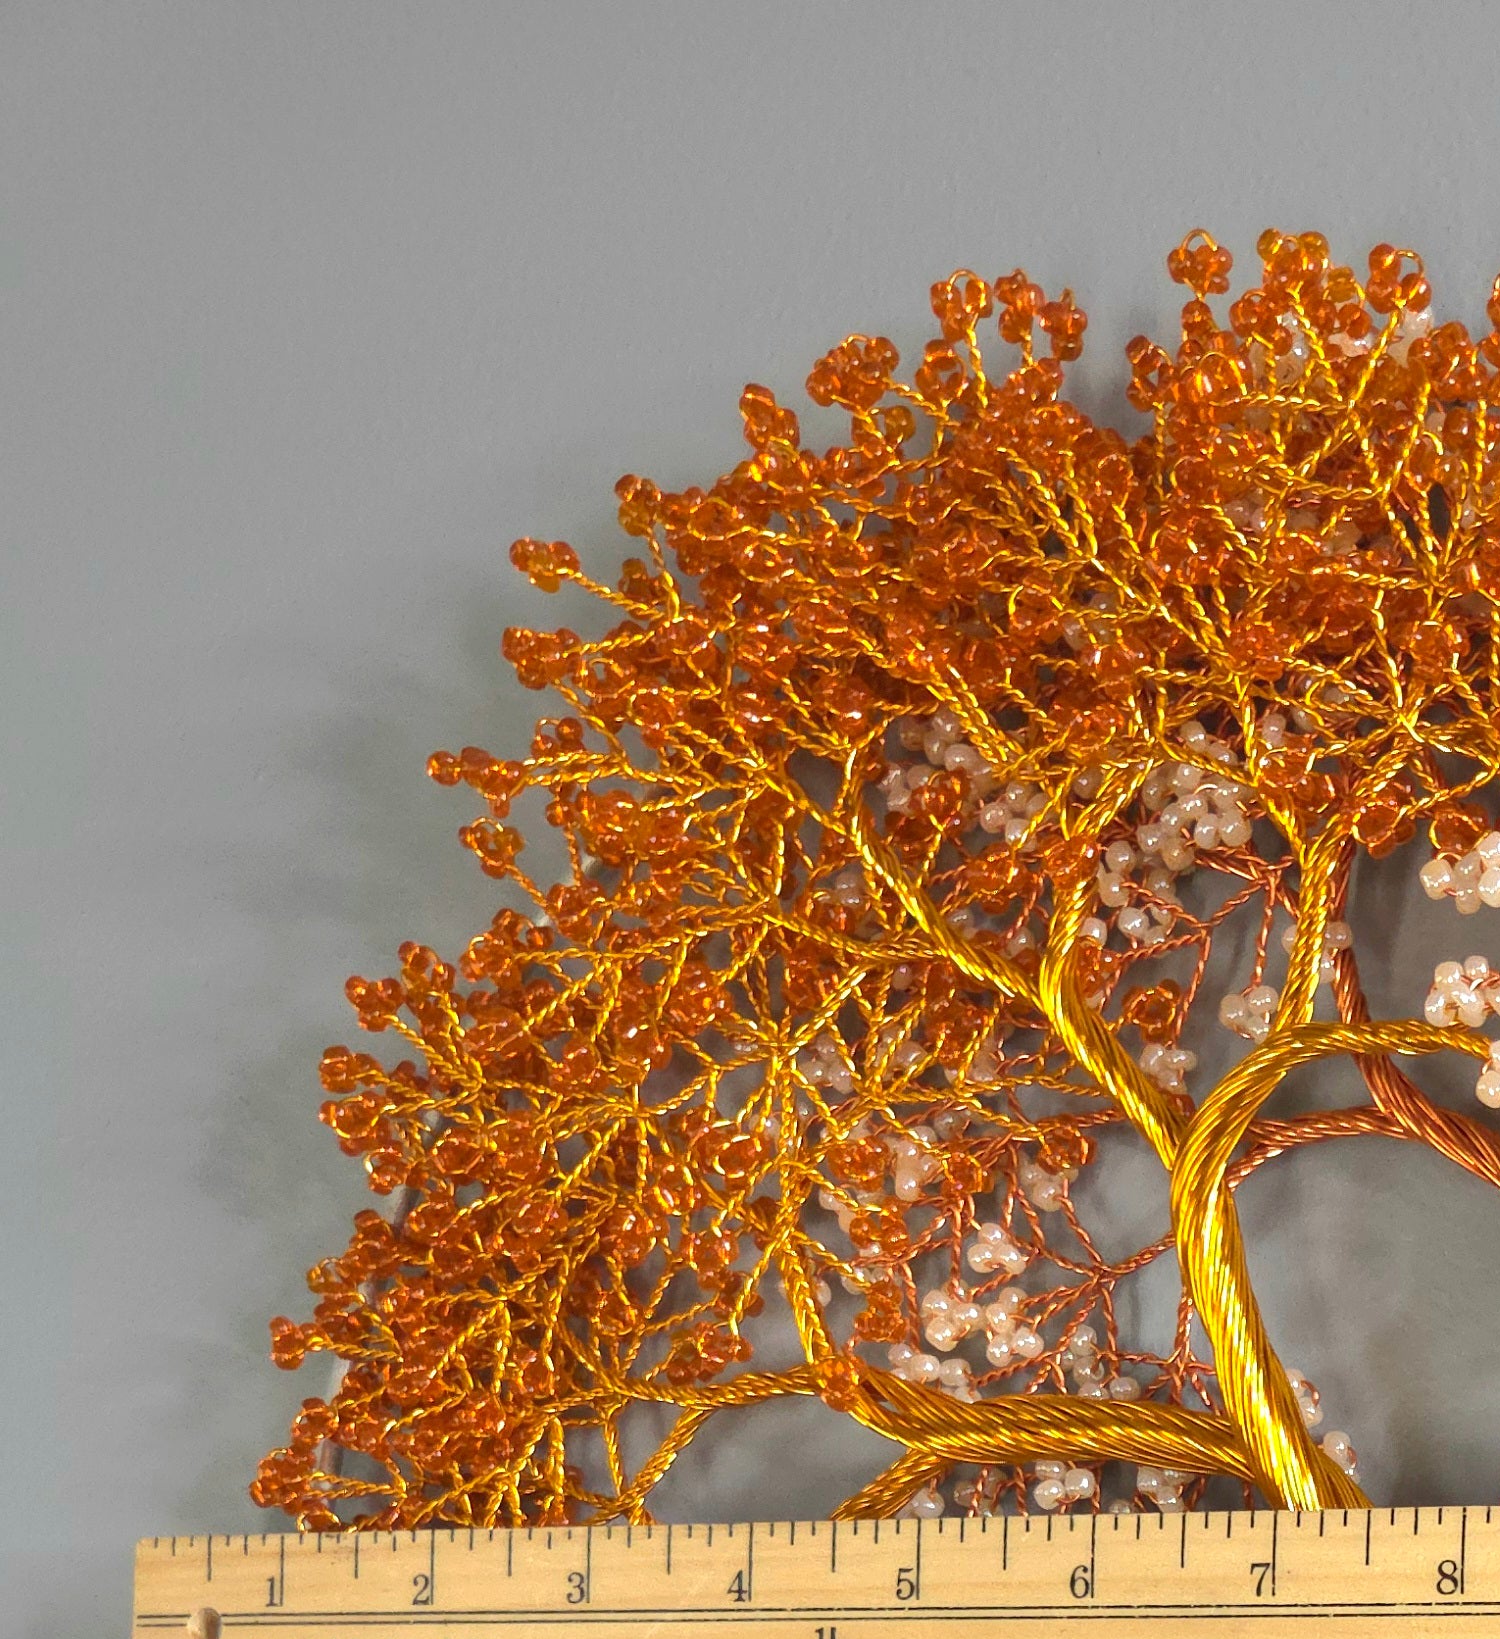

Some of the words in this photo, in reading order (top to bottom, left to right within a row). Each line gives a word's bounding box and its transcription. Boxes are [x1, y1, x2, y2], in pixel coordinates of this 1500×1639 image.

[265, 1575, 279, 1607] 1
[412, 1573, 431, 1605] 2
[566, 1572, 586, 1603] 3
[727, 1571, 748, 1602] 4
[895, 1569, 916, 1600] 5
[1069, 1566, 1089, 1599] 6
[1250, 1564, 1270, 1596] 7
[1436, 1561, 1459, 1594] 8
